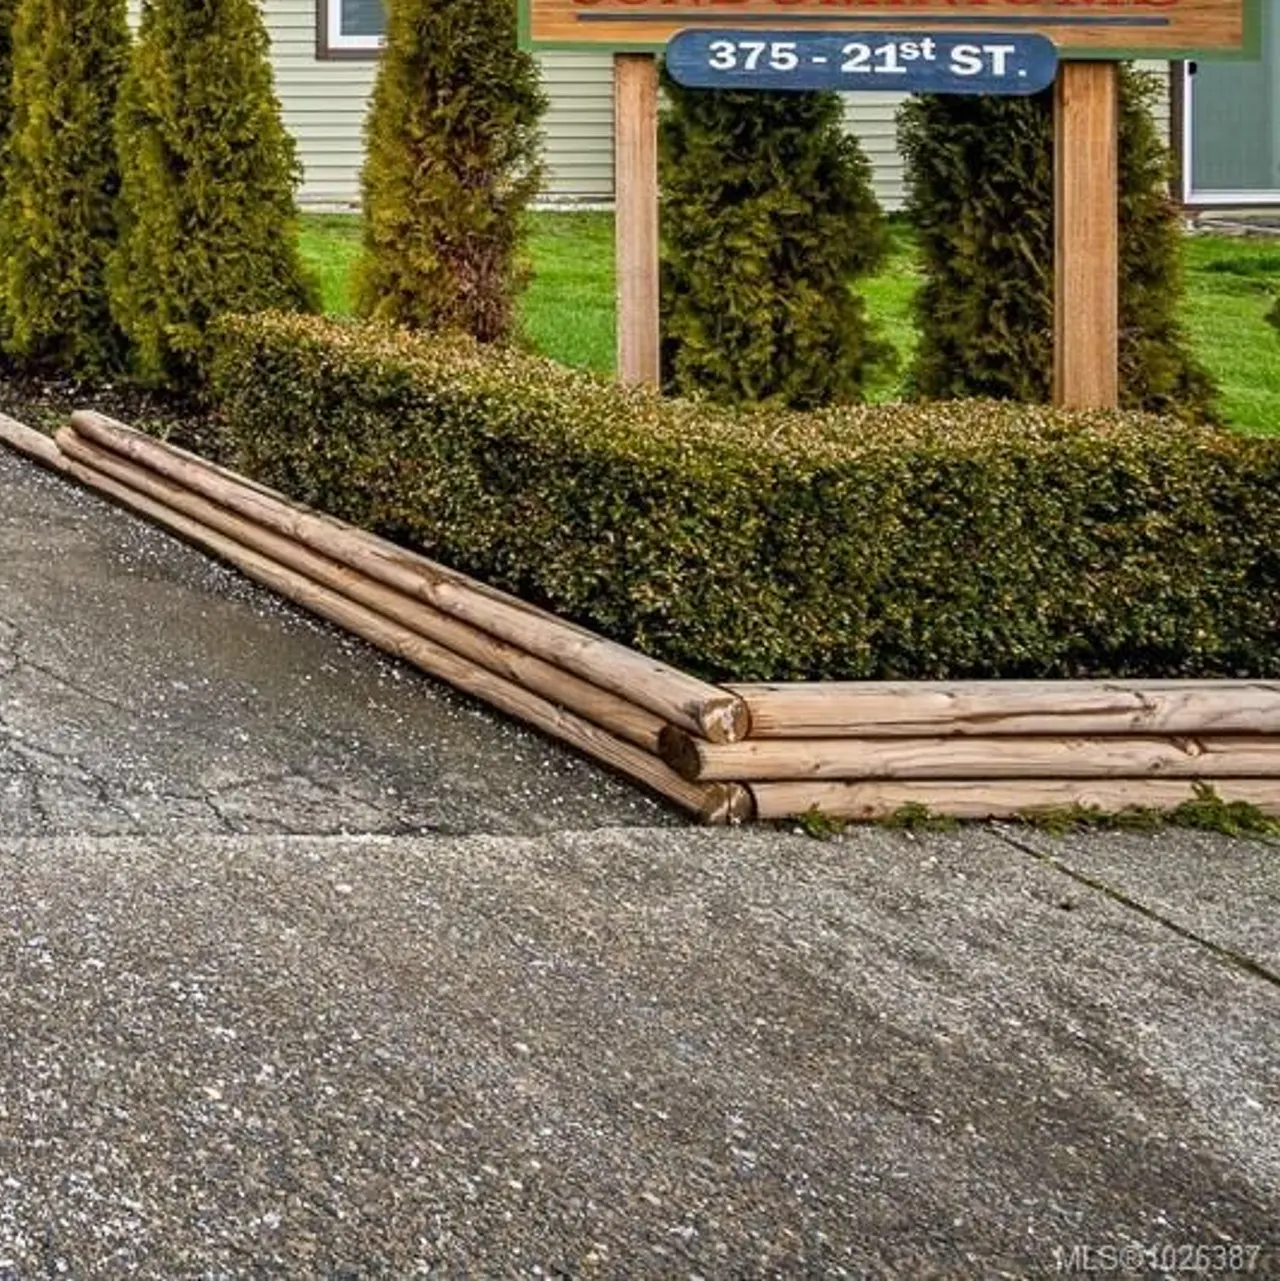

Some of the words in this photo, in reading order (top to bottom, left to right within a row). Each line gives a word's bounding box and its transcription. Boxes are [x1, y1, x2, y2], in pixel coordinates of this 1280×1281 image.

[707, 40, 799, 71] 375
[840, 36, 937, 73] 21st
[948, 44, 1028, 77] ST.
